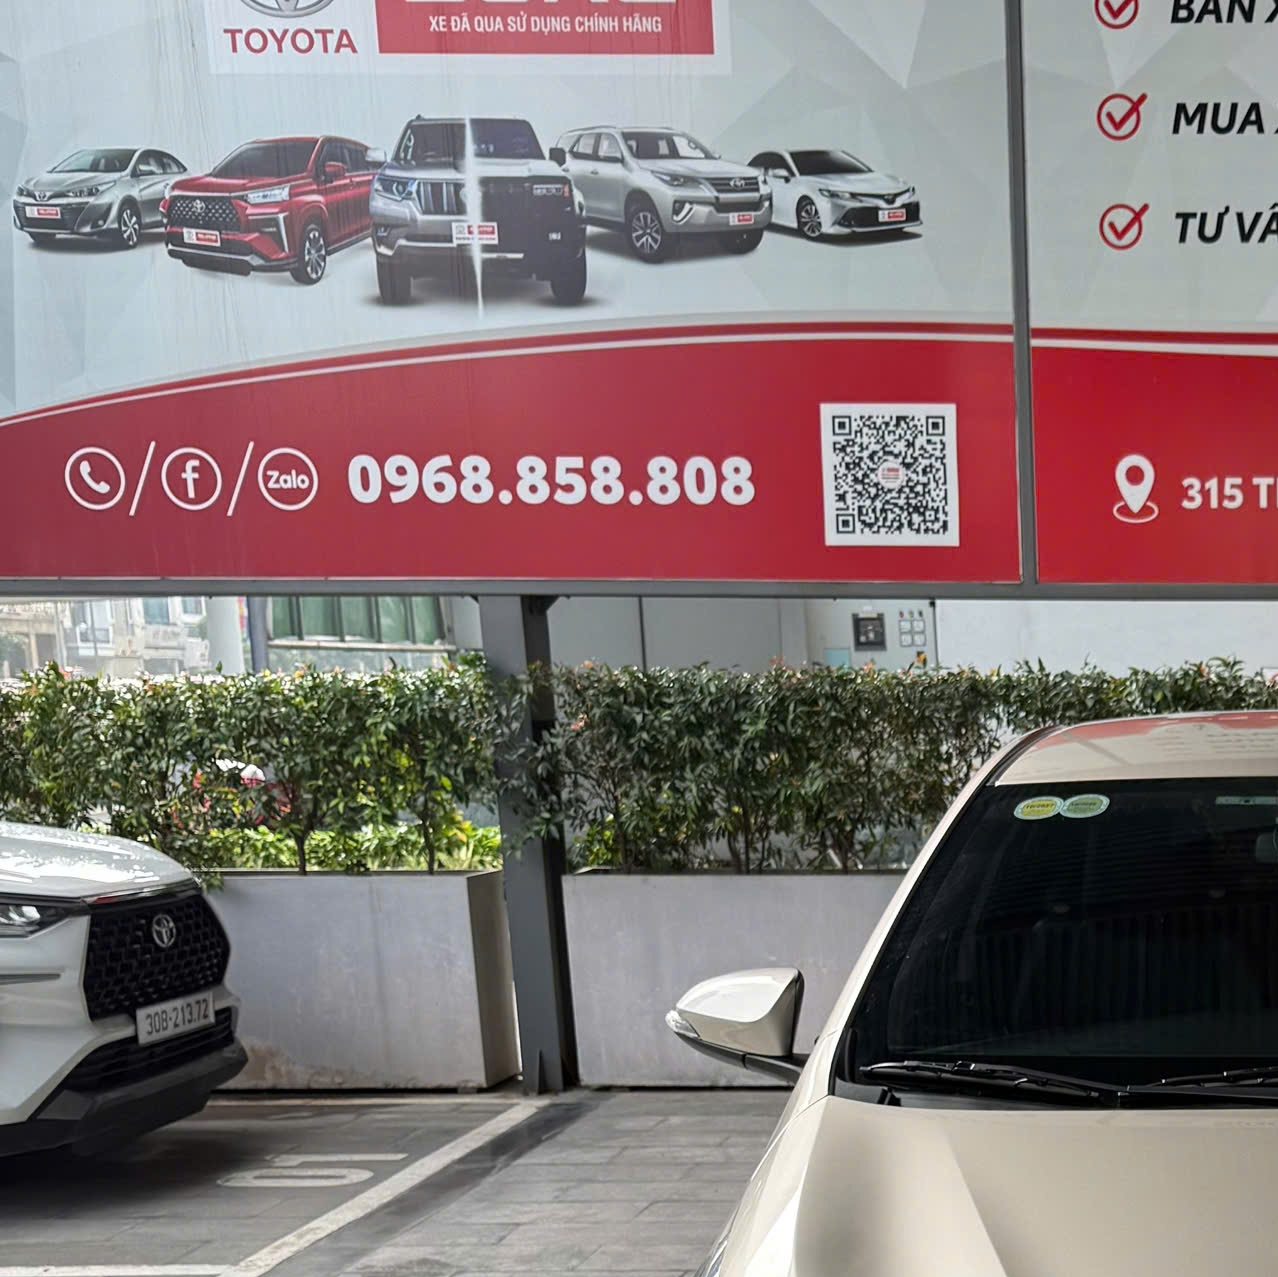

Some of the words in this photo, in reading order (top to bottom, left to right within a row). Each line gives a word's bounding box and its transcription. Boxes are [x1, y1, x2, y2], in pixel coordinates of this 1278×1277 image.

[429, 15, 447, 32] XE
[450, 12, 471, 32] ĐÃ
[474, 15, 504, 32] QUA
[507, 11, 527, 32] SỬ
[530, 15, 570, 35] DỤNG
[575, 12, 618, 32] CHÍNH
[622, 13, 662, 32] HÃNG
[223, 28, 358, 54] TOYOTA
[1172, 102, 1265, 134] MUA
[1175, 207, 1230, 243] TƯ
[266, 469, 310, 489] Zalo
[348, 454, 755, 505] 0968.858.808
[1182, 477, 1243, 509] 315
